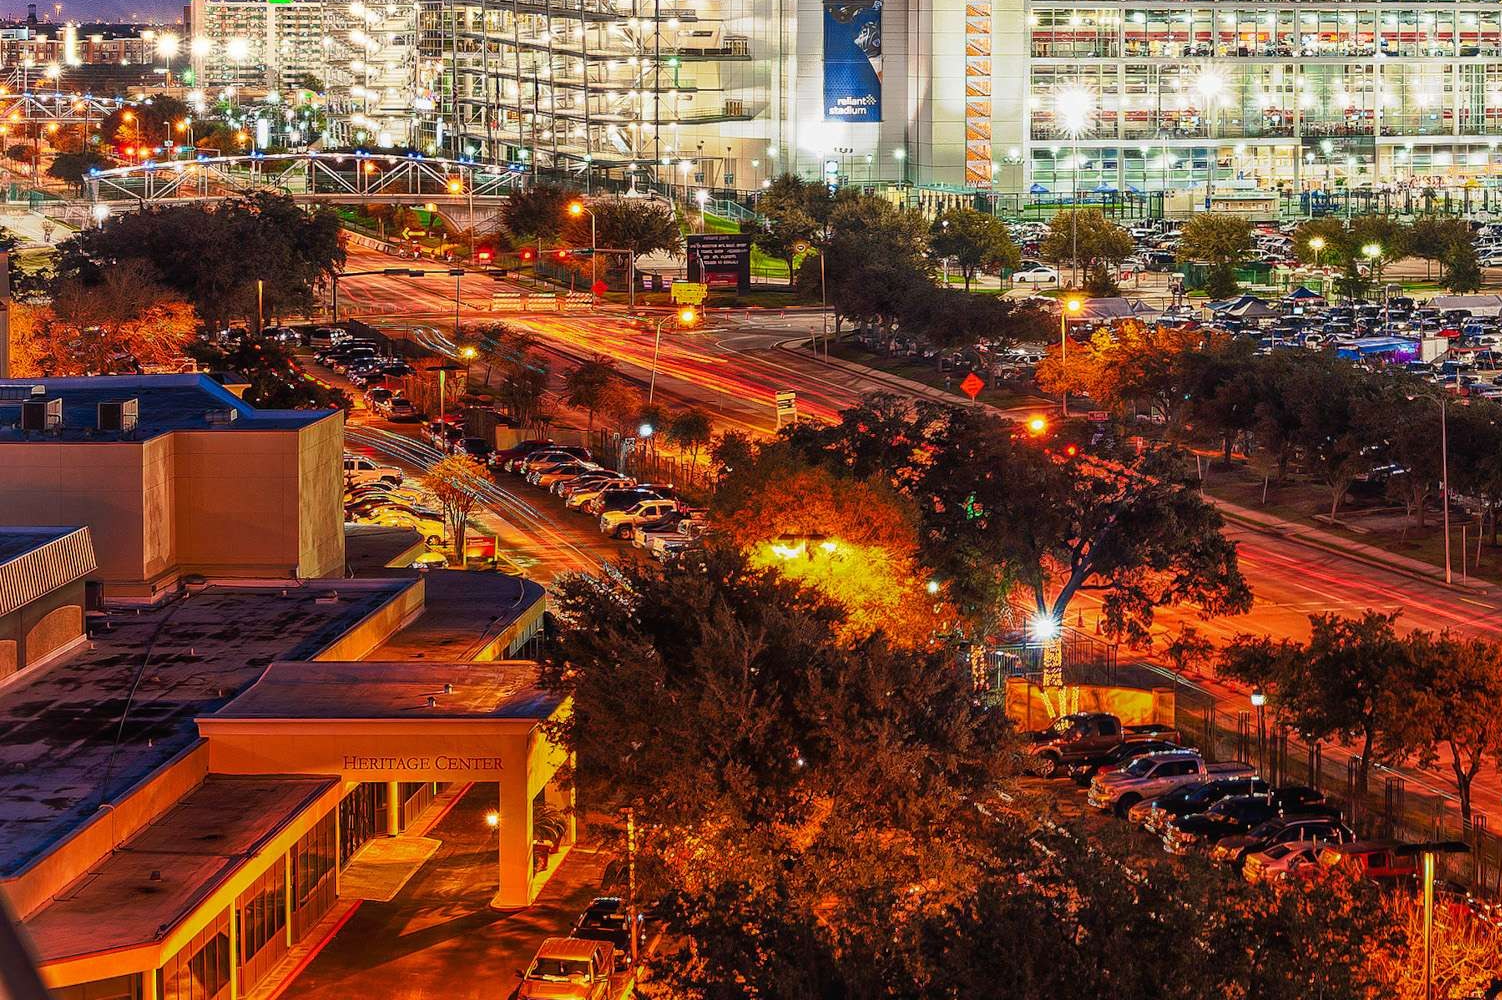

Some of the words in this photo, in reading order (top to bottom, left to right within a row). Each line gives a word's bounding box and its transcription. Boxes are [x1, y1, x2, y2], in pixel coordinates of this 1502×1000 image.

[837, 96, 866, 106] reliant
[829, 106, 867, 115] stadium
[343, 755, 430, 770] HERITAGE
[435, 755, 504, 770] CENTER
